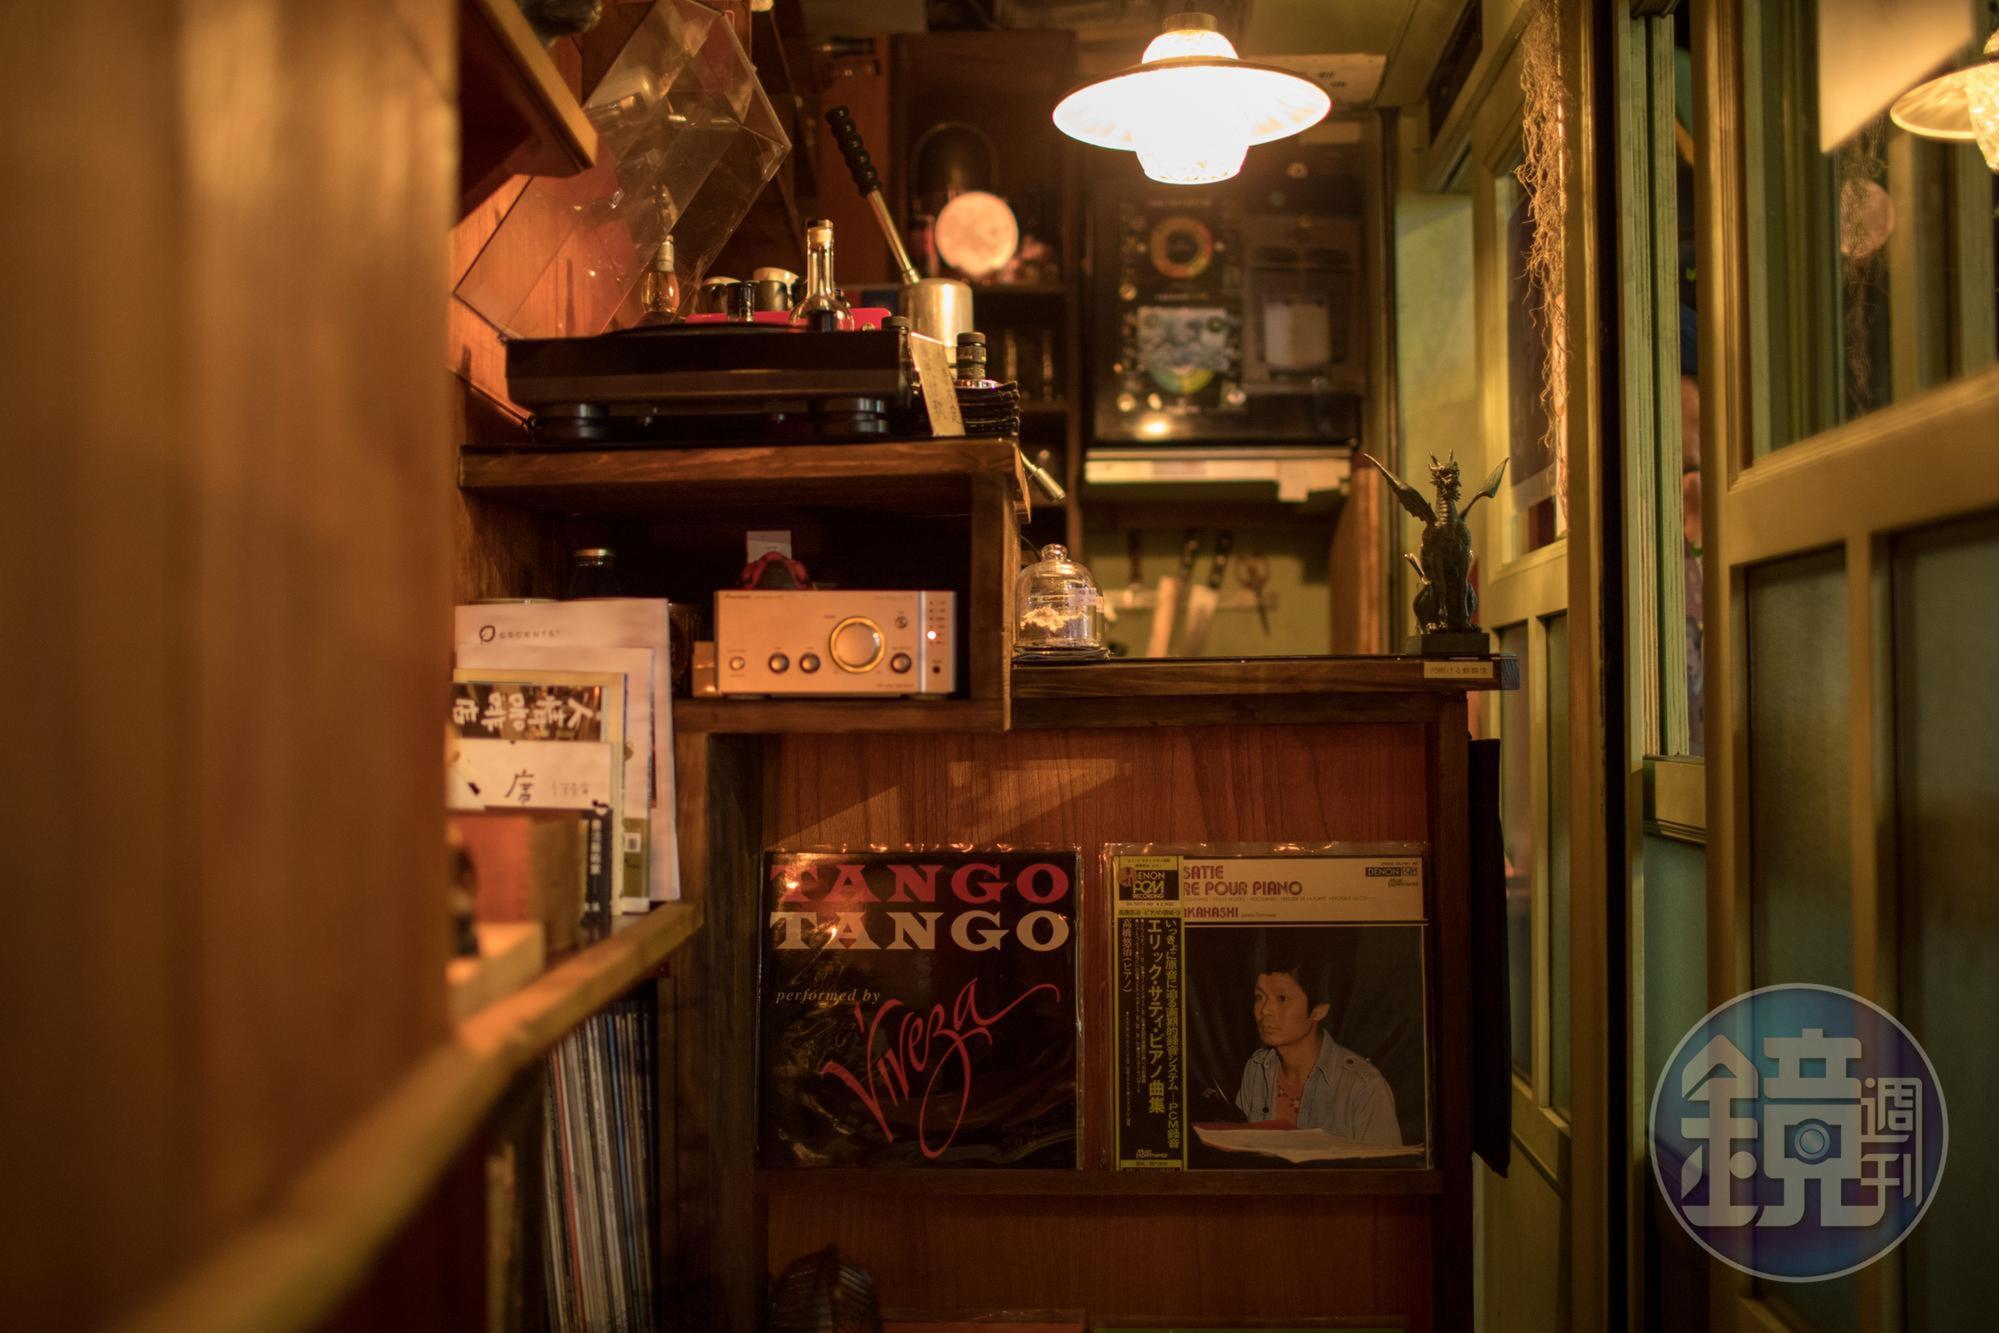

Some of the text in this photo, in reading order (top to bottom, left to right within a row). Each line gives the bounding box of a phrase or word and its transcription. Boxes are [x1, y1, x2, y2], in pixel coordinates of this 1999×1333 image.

[1183, 865, 1224, 880] SATIE
[770, 863, 1070, 904] TANGO
[1204, 881, 1248, 896] POUR
[1252, 881, 1304, 896] PIANO
[769, 910, 1070, 952] TANGO
[775, 988, 881, 1005] performed by
